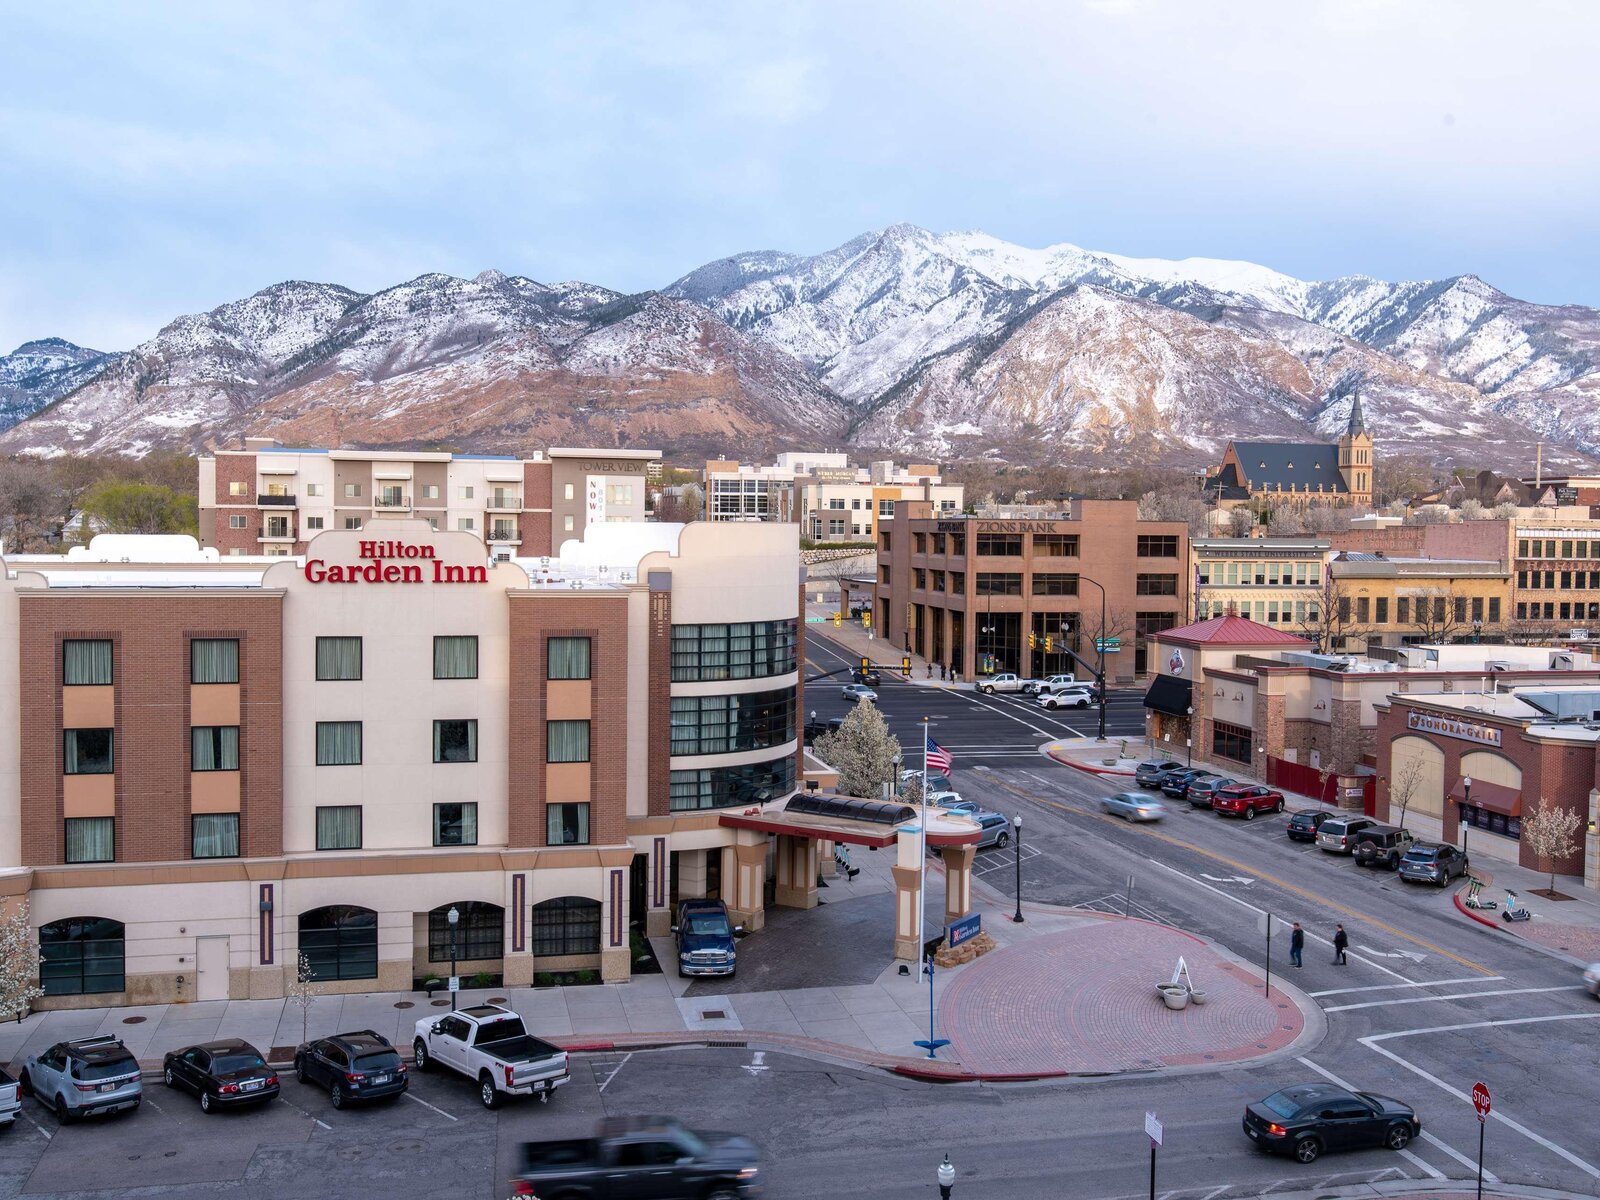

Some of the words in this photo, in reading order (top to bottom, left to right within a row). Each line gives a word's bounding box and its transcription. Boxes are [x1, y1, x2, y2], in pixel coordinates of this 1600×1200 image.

[577, 462, 616, 472] TOWER
[617, 462, 643, 472] VIEW
[589, 481, 597, 510] NOW
[976, 521, 1016, 533] ZIONS
[1019, 521, 1057, 533] BANK
[359, 541, 436, 559] Hilton
[304, 559, 424, 584] Garden
[432, 560, 489, 584] Inn
[1421, 718, 1462, 734] SONORA
[1466, 727, 1499, 743] GRILL
[1473, 1089, 1490, 1108] STOP
